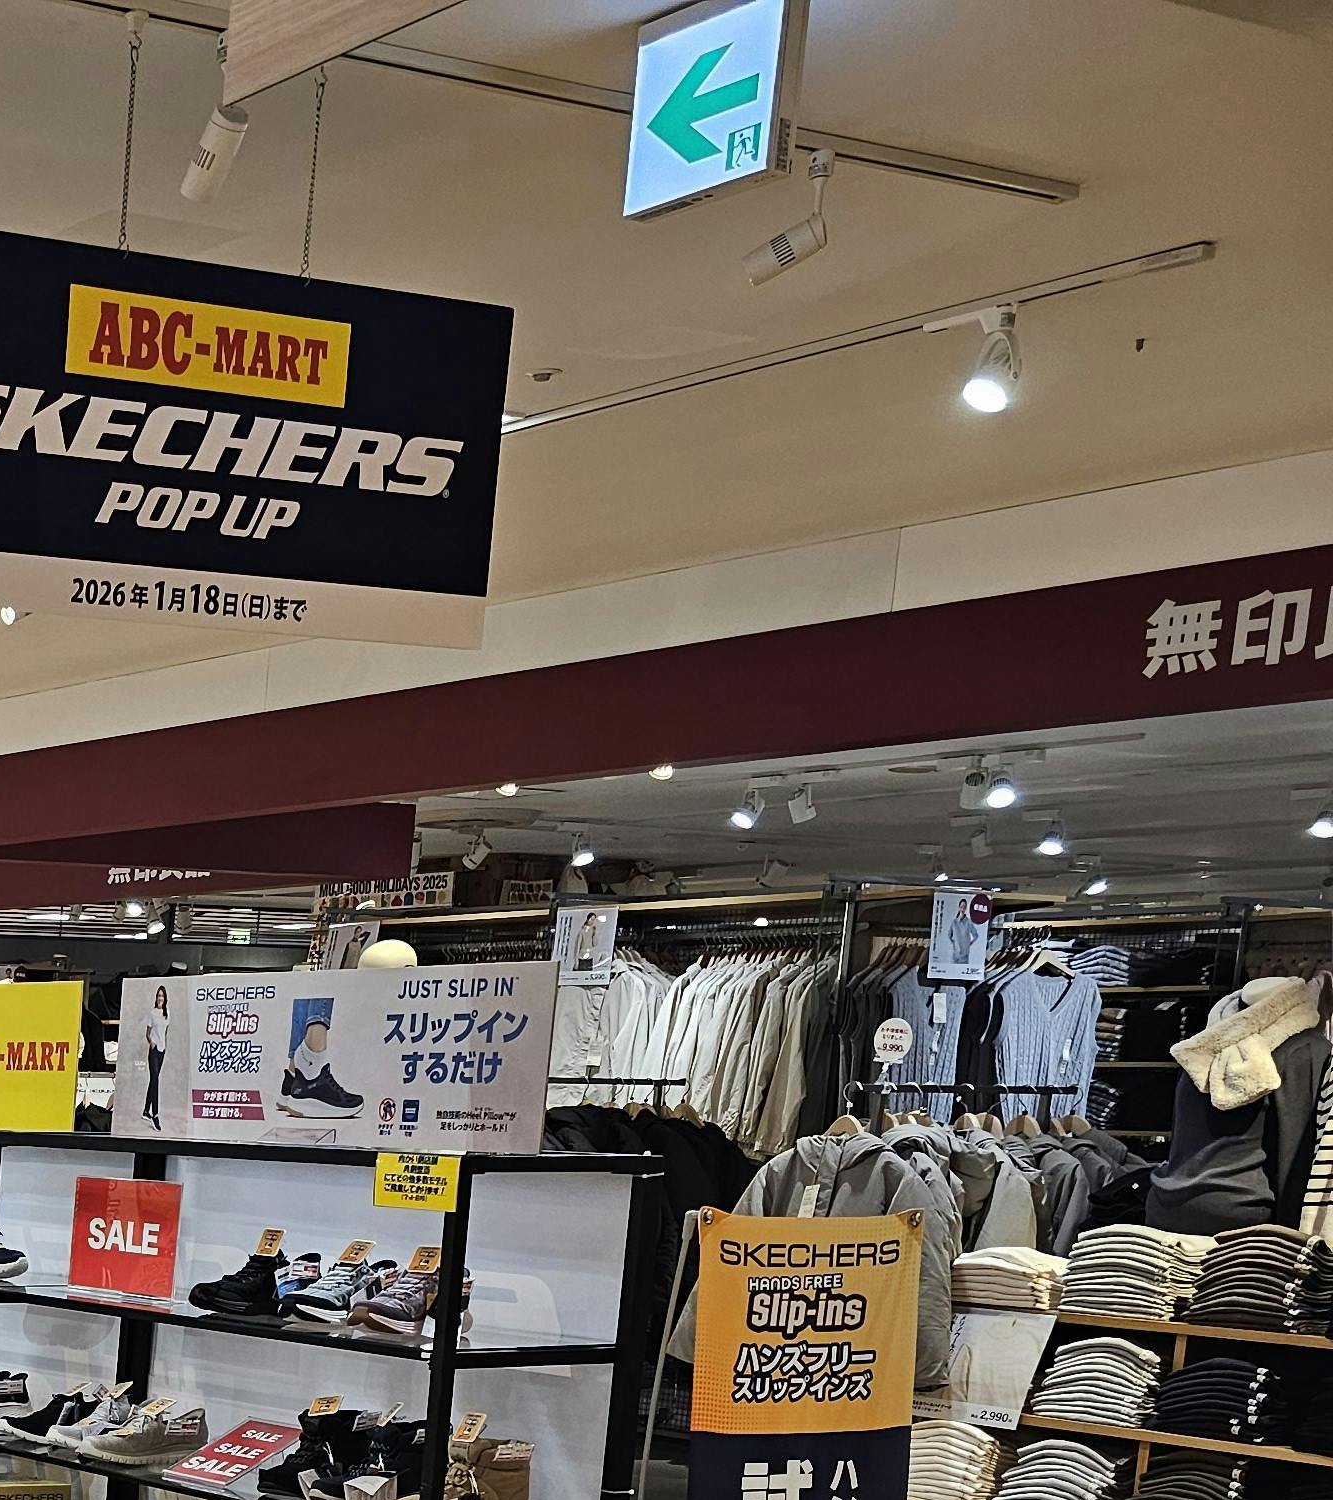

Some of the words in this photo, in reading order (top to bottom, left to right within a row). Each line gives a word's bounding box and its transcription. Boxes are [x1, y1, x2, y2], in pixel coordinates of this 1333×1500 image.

[89, 302, 328, 385] ABC-MART
[94, 482, 212, 532] POP
[217, 494, 301, 540] UP
[1141, 585, 1333, 679] 無印
[347, 881, 371, 895] GOOD
[374, 877, 420, 894] HOLIDAYS
[423, 875, 448, 890] 2025
[196, 986, 276, 1001] SKECHERS
[397, 979, 443, 999] JUST
[446, 978, 489, 999] SLIP
[207, 1013, 259, 1038] Slip-ins
[384, 1010, 529, 1045] スリップイン
[201, 1041, 262, 1058] ハンズフリー
[199, 1057, 260, 1073] スリップインズ
[402, 1050, 502, 1085] するだけ
[88, 1217, 160, 1256] SALE
[720, 1239, 900, 1268] SKECHERS
[748, 1275, 799, 1292] HANDS
[804, 1273, 843, 1290] FREE
[749, 1291, 865, 1337] Slip-ins
[734, 1343, 876, 1374] ハンズフリー
[733, 1373, 871, 1401] スリップインズ
[242, 1429, 283, 1443] SALE
[214, 1443, 265, 1460] SALE
[182, 1456, 249, 1478] SALE
